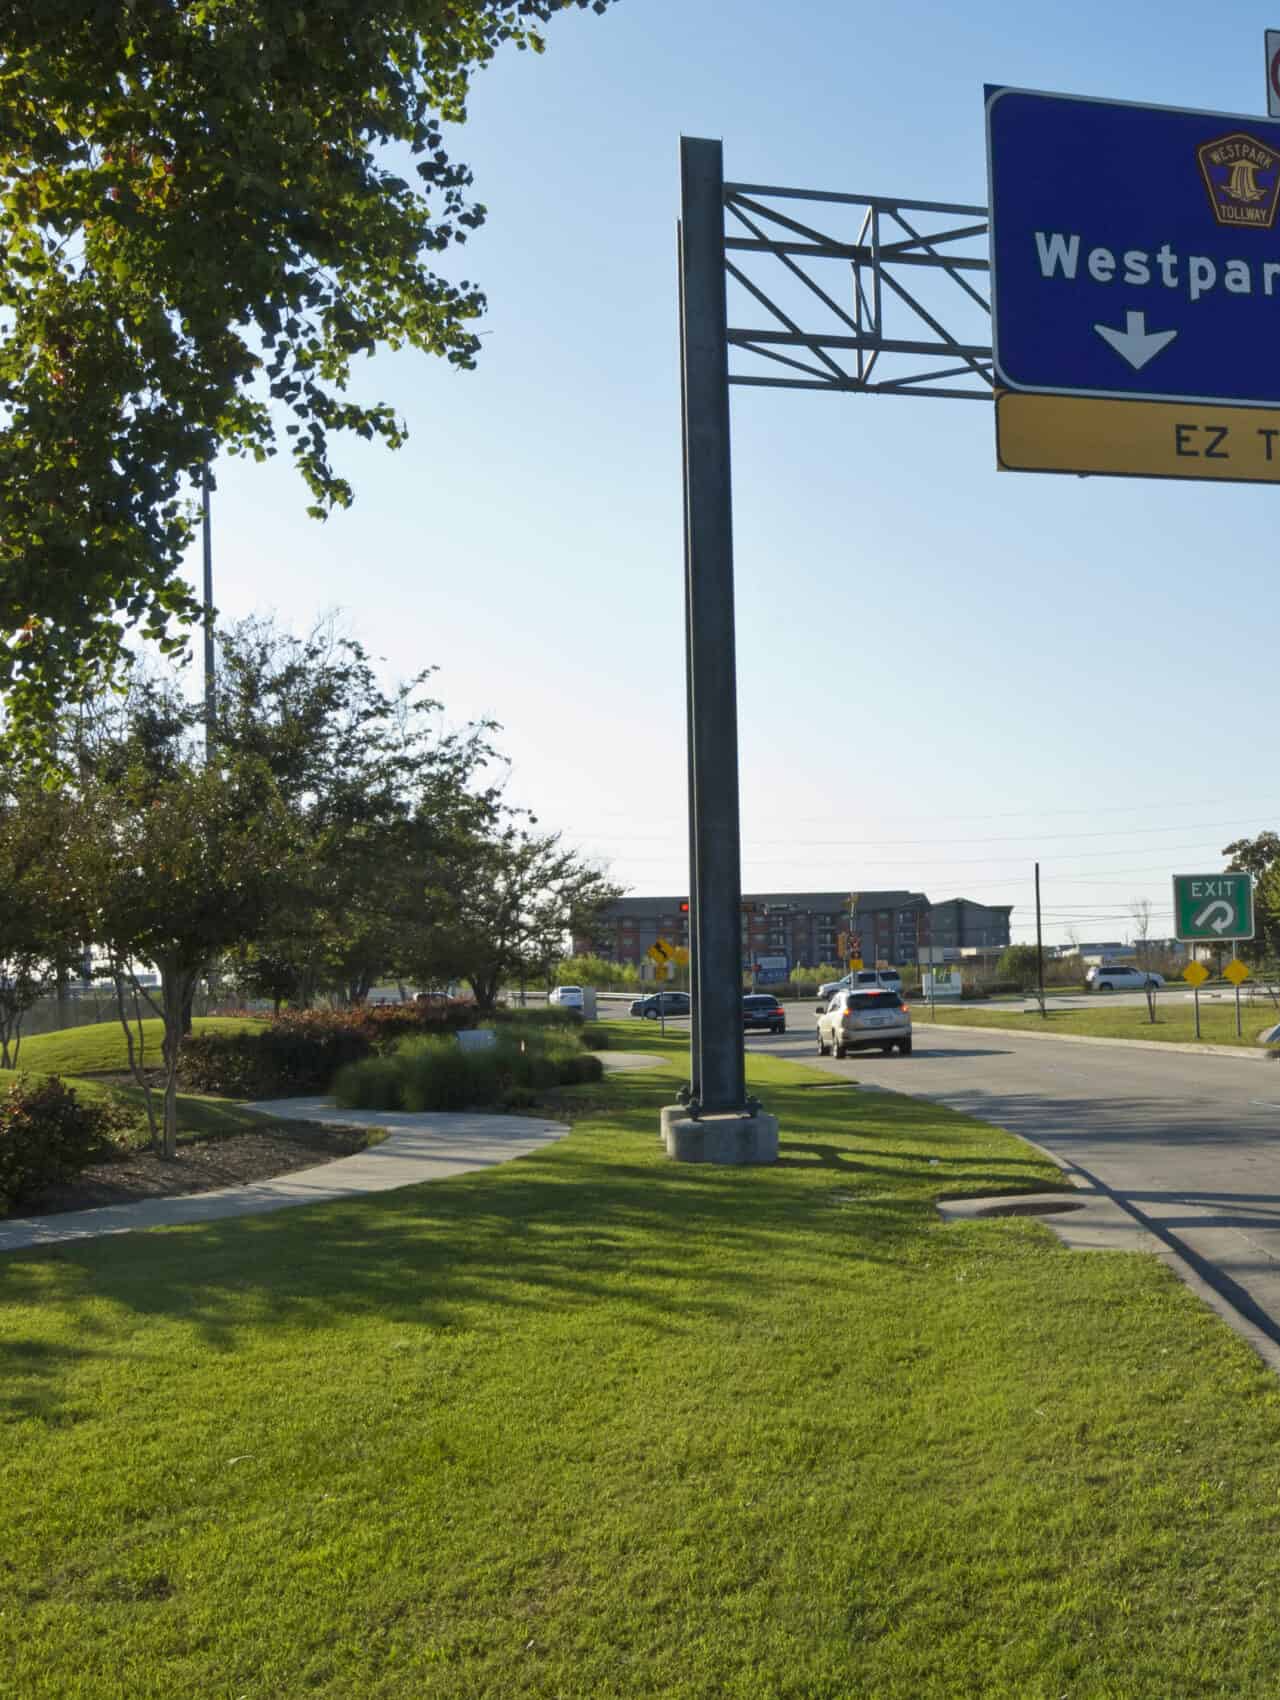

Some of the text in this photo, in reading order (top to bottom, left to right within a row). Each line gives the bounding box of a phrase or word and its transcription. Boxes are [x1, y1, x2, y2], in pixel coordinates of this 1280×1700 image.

[1210, 143, 1273, 168] WESTPARK
[1219, 204, 1268, 222] TOLLWAY
[1174, 423, 1230, 459] EZ
[1191, 880, 1235, 897] EXIT
